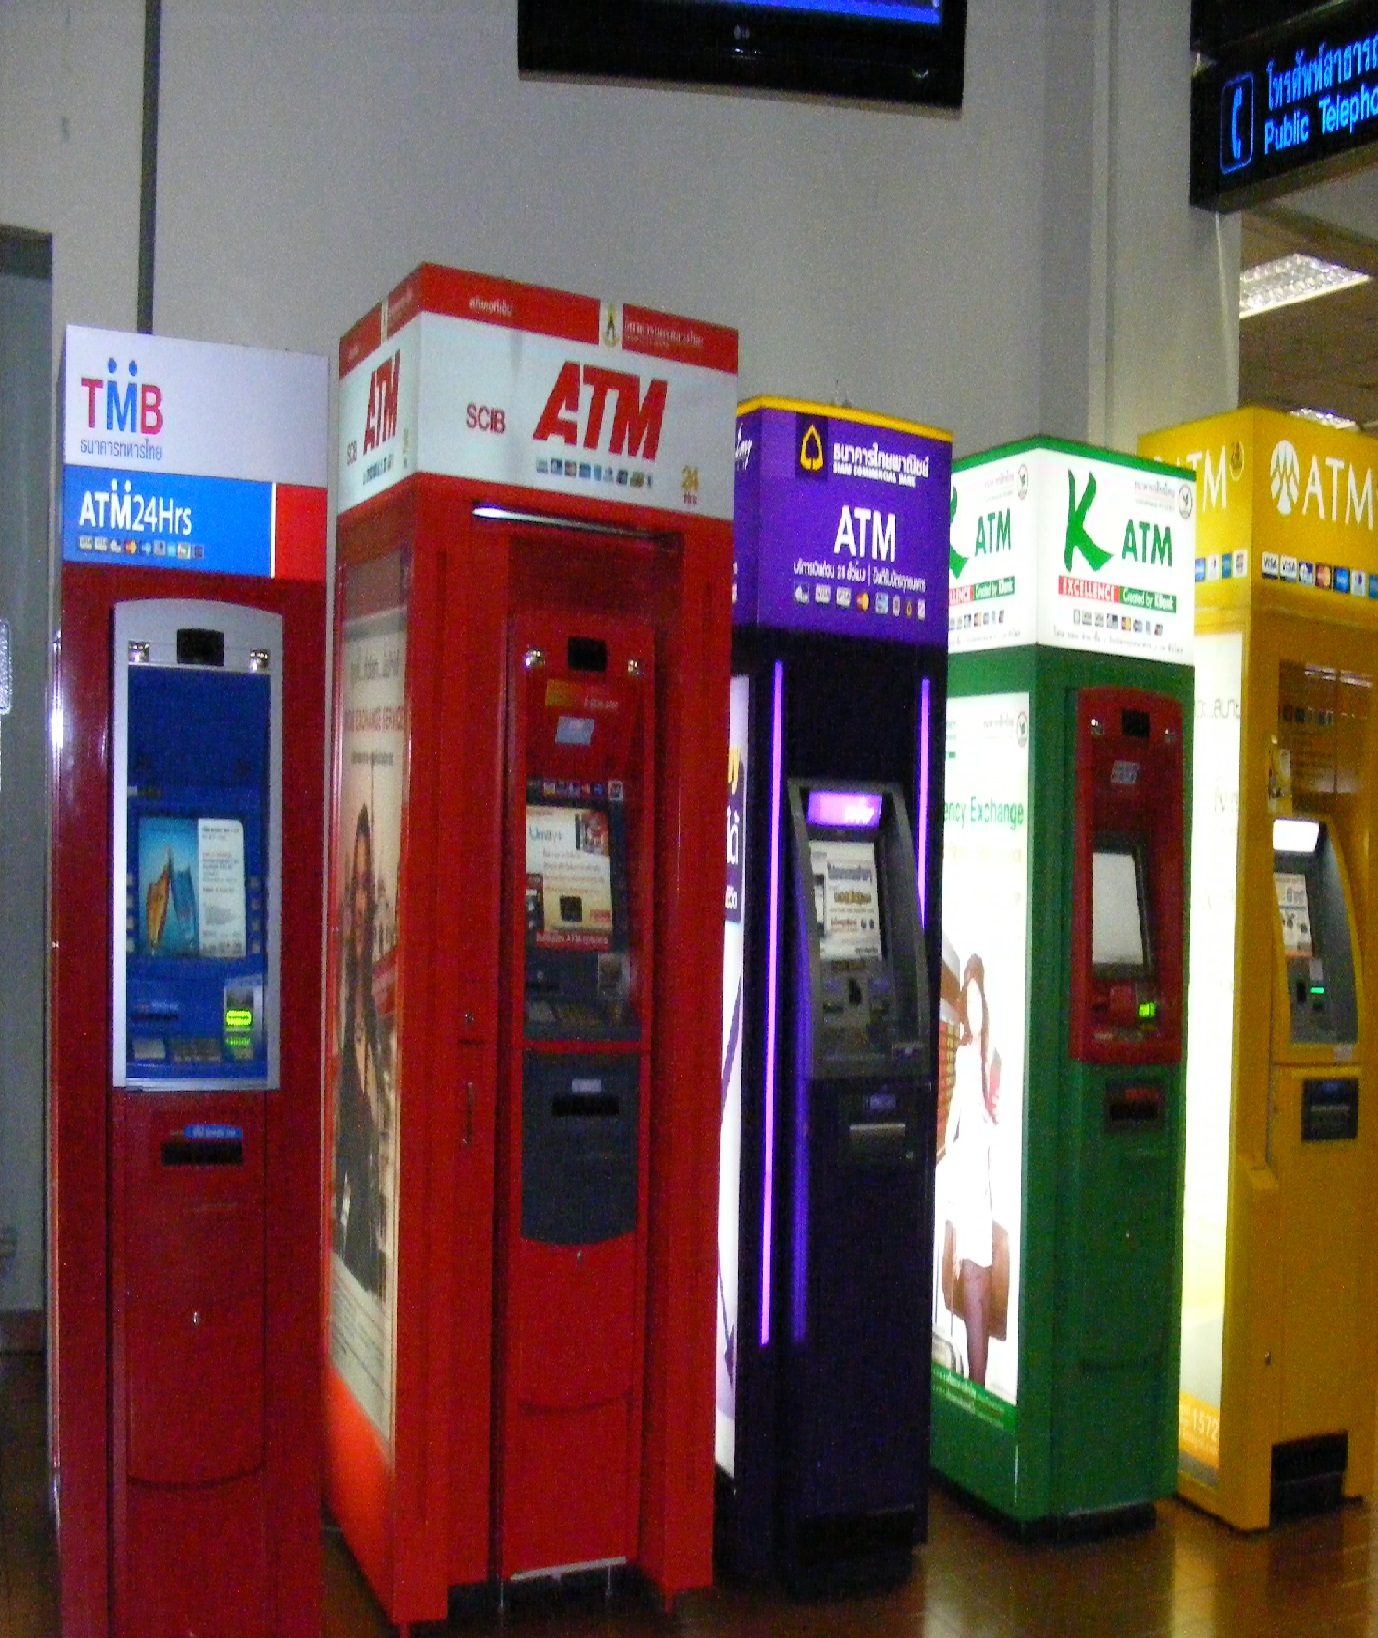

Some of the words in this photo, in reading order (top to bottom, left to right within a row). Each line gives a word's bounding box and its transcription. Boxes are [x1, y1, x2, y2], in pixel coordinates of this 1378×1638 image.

[1264, 110, 1309, 154] Public
[81, 358, 164, 435] TMB
[363, 349, 401, 455] ATM
[466, 403, 506, 434] SCIB
[533, 361, 668, 461] ATM
[80, 438, 164, 461] ธนาคารทหารไทย
[1177, 445, 1227, 513] TM
[1302, 455, 1374, 530] ATM
[833, 504, 896, 563] ATM
[975, 507, 1012, 557] ATM
[1064, 469, 1115, 573] K
[1122, 518, 1173, 568] ATM
[1062, 578, 1115, 603] EXCELLENCE
[970, 796, 1025, 831] Exchange
